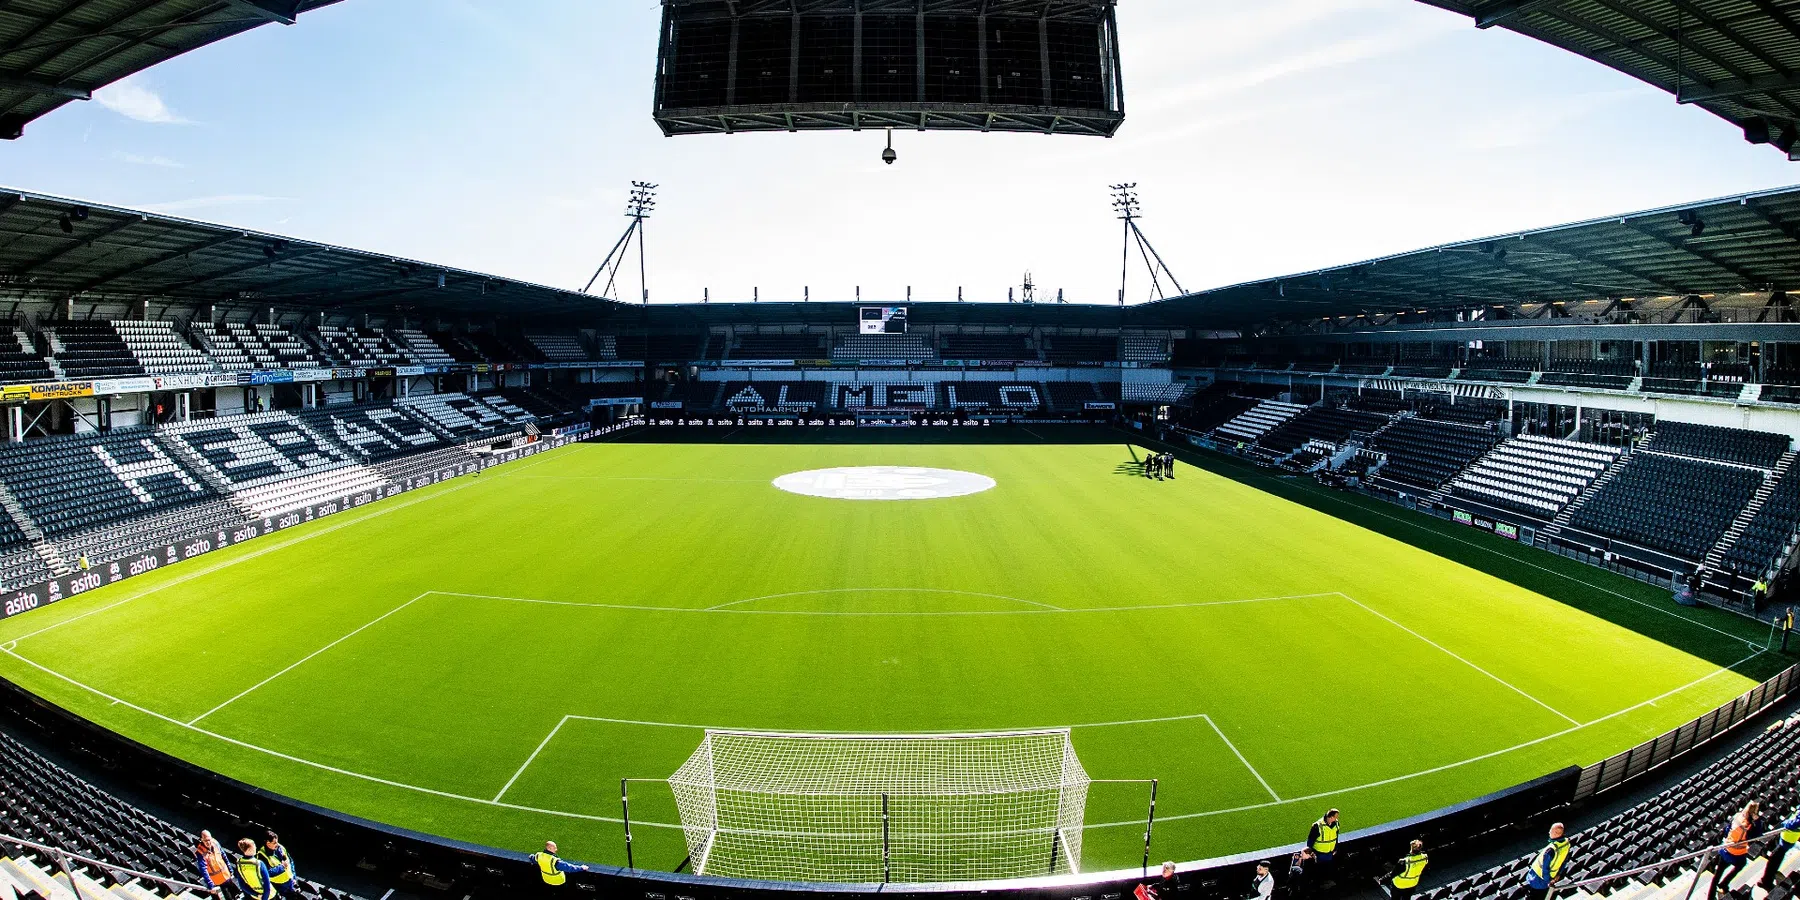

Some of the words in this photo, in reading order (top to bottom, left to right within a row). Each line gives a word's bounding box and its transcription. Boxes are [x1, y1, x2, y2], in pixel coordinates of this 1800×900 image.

[163, 375, 203, 387] KIENHUIS
[251, 374, 274, 383] Primo
[32, 382, 92, 393] KOMPACTOR
[387, 484, 402, 496] asito
[355, 492, 372, 506] asito
[319, 500, 337, 516] asito
[279, 513, 299, 528] asito
[234, 525, 257, 542] asito
[185, 539, 210, 557] asito
[130, 555, 157, 575] asito
[71, 572, 101, 594] asito
[5, 592, 38, 615] asito
